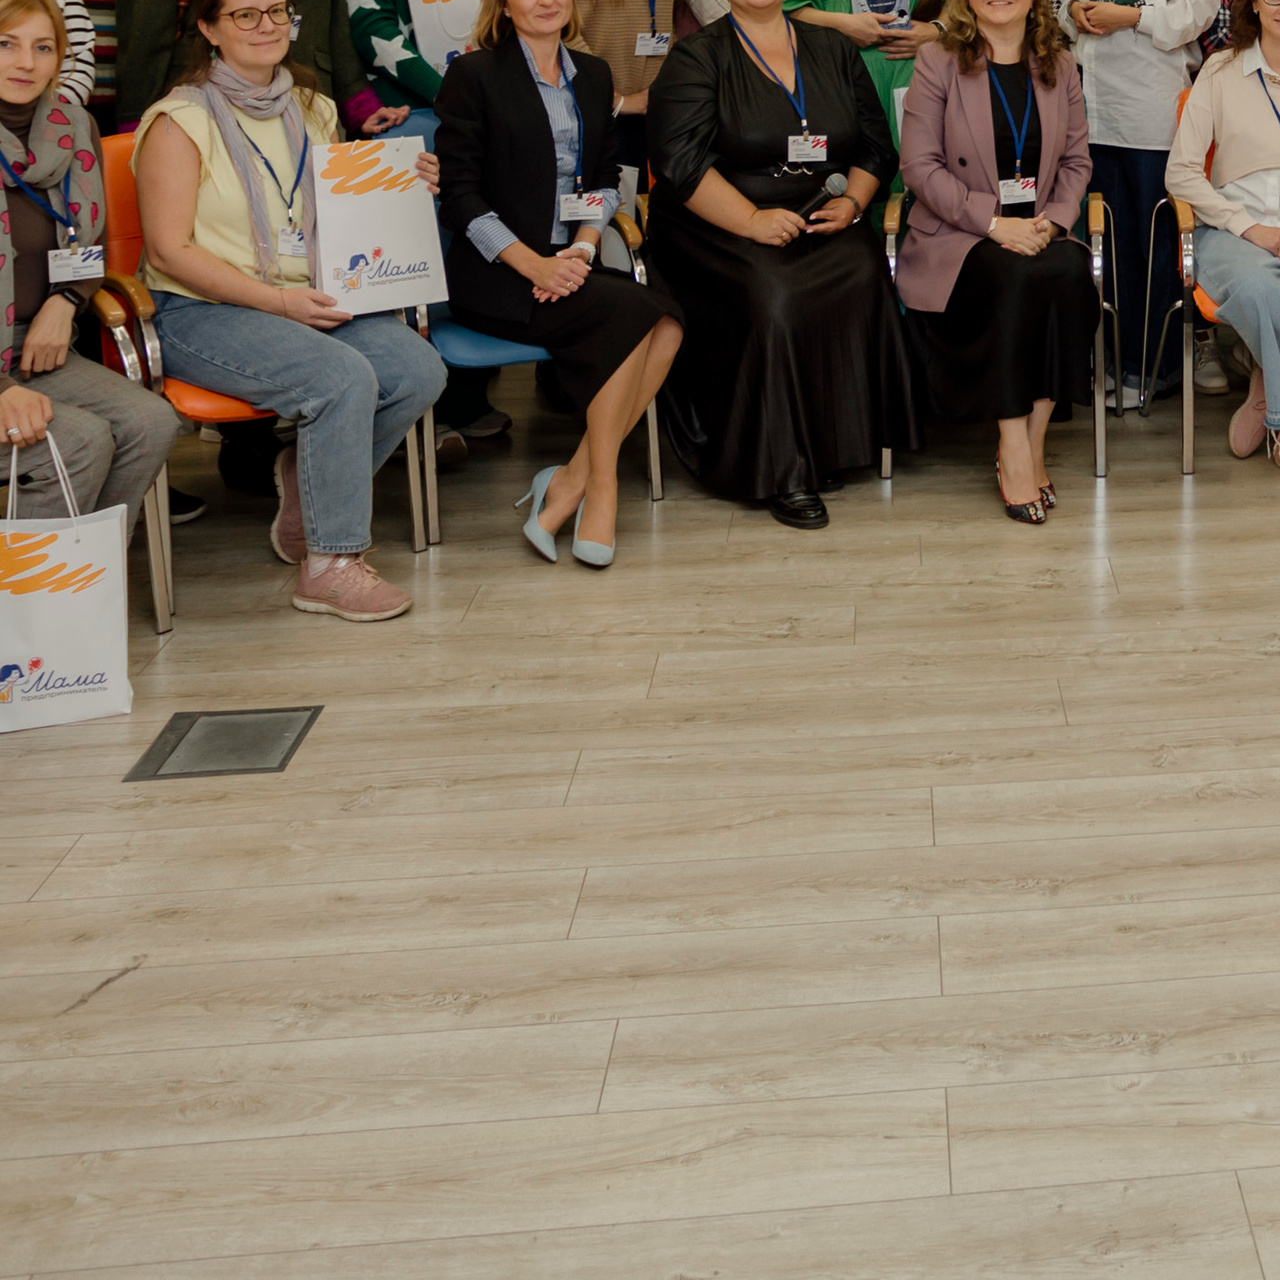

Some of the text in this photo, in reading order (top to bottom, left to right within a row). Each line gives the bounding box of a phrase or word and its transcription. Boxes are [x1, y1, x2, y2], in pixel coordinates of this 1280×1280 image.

[367, 258, 430, 280] Мама
[367, 273, 431, 287] предприниматель
[21, 670, 108, 694] Мама
[20, 686, 108, 702] предприниматель
